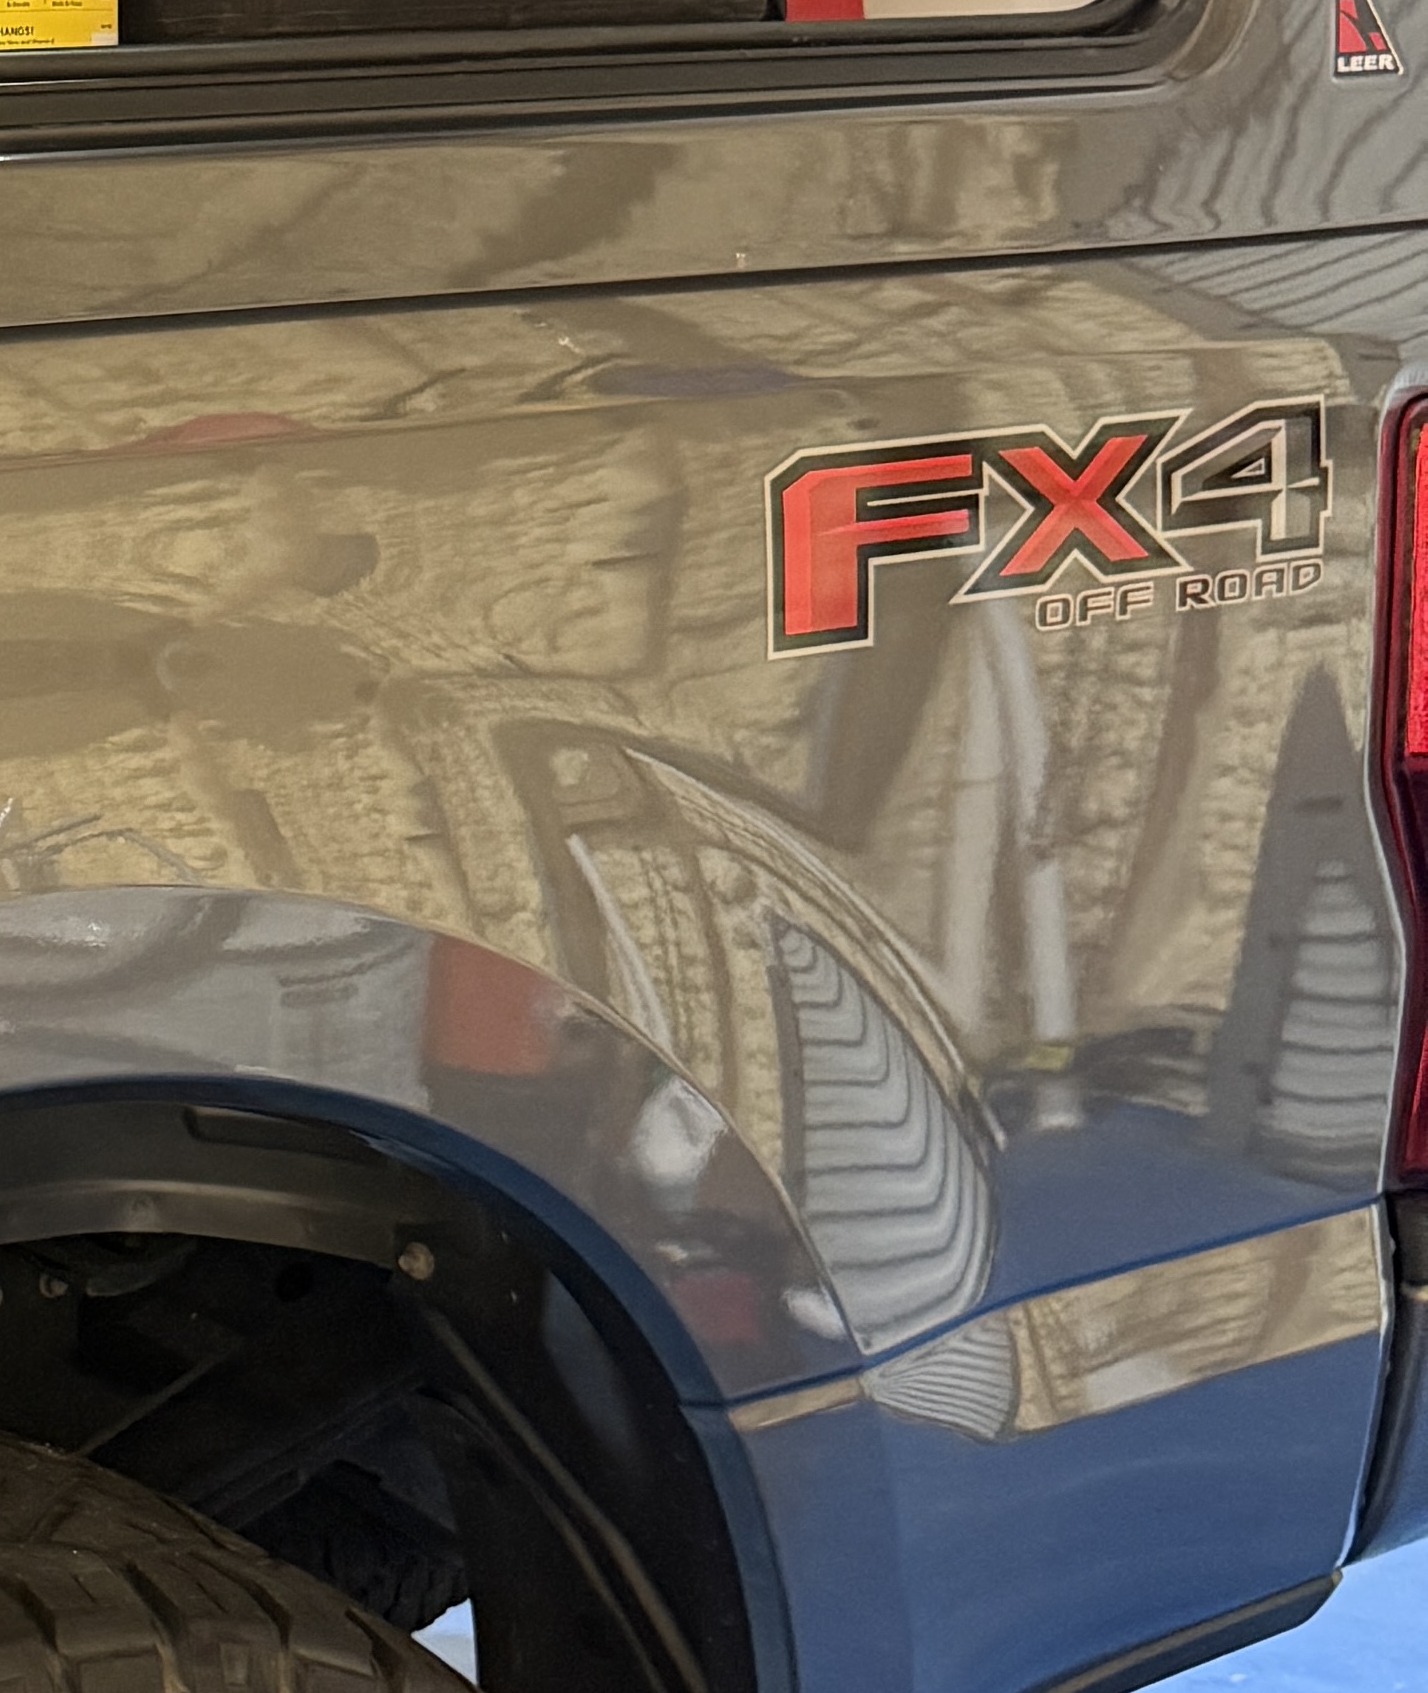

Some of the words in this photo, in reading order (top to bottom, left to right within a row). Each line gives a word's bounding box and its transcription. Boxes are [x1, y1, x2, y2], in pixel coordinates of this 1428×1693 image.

[1337, 53, 1395, 73] LEER
[764, 394, 1333, 661] FX4
[1035, 581, 1155, 631] OFF
[1175, 558, 1325, 612] ROAD
